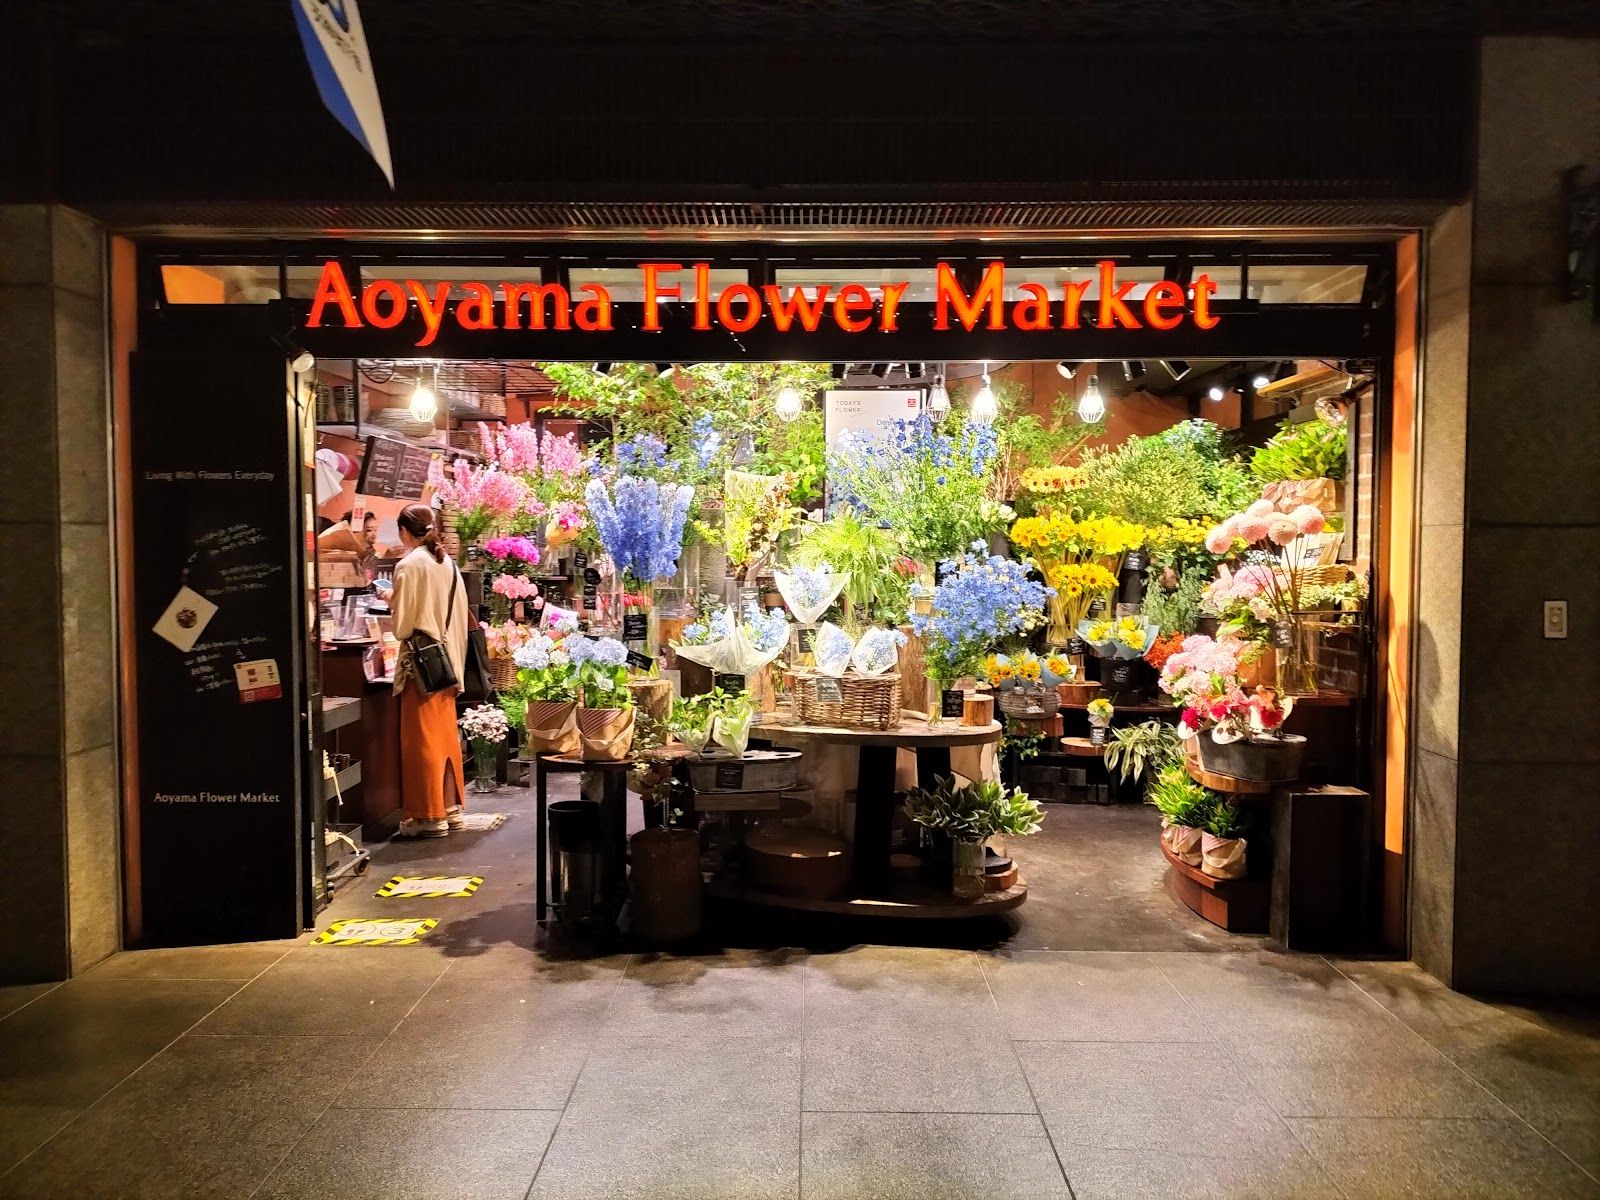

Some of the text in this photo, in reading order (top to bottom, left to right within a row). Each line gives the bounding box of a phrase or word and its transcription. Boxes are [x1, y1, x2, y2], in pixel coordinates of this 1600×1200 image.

[306, 260, 1222, 347] Aoyama Flower Market
[198, 470, 232, 481] Flowers
[234, 470, 275, 483] Everyday
[153, 792, 280, 804] Aoyama Flower Market
